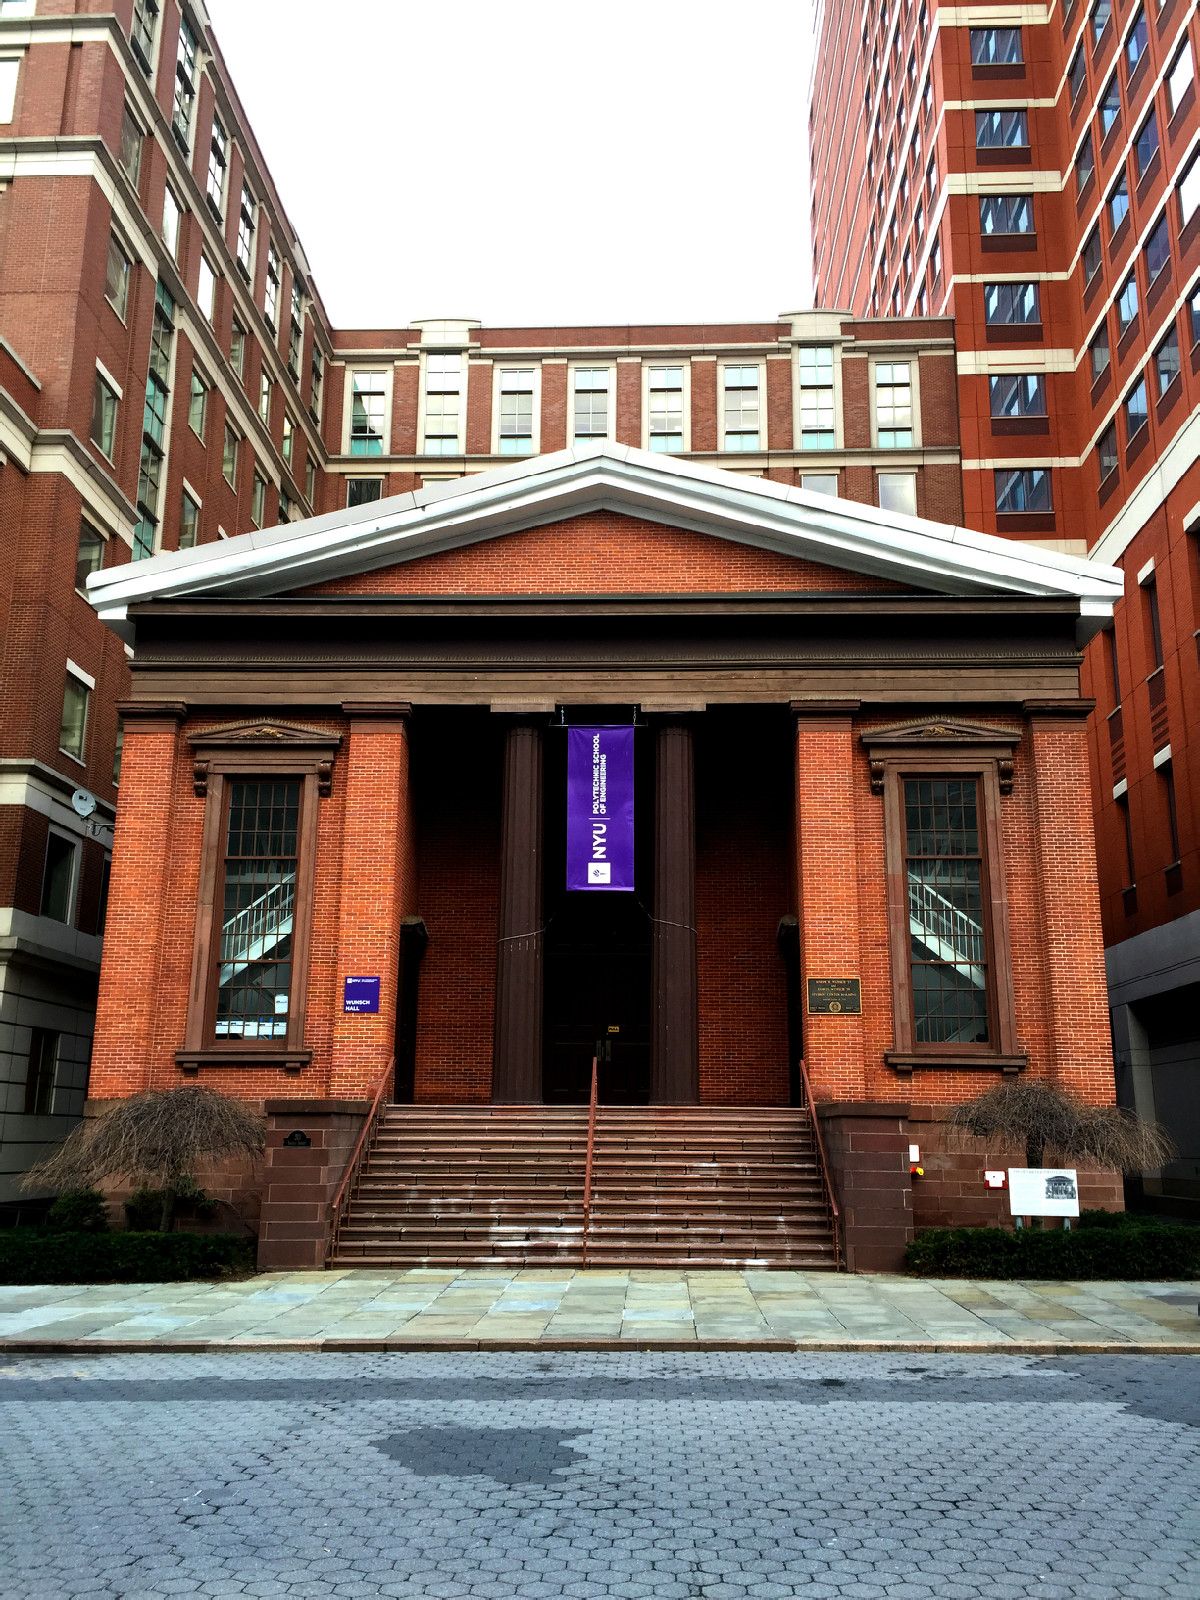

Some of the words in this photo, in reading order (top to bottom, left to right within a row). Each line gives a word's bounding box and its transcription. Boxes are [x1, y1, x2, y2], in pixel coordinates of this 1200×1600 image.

[592, 733, 600, 764] SCHOOL
[592, 764, 600, 815] POLYTECHNIC
[600, 803, 607, 815] OF
[592, 823, 607, 859] NYU
